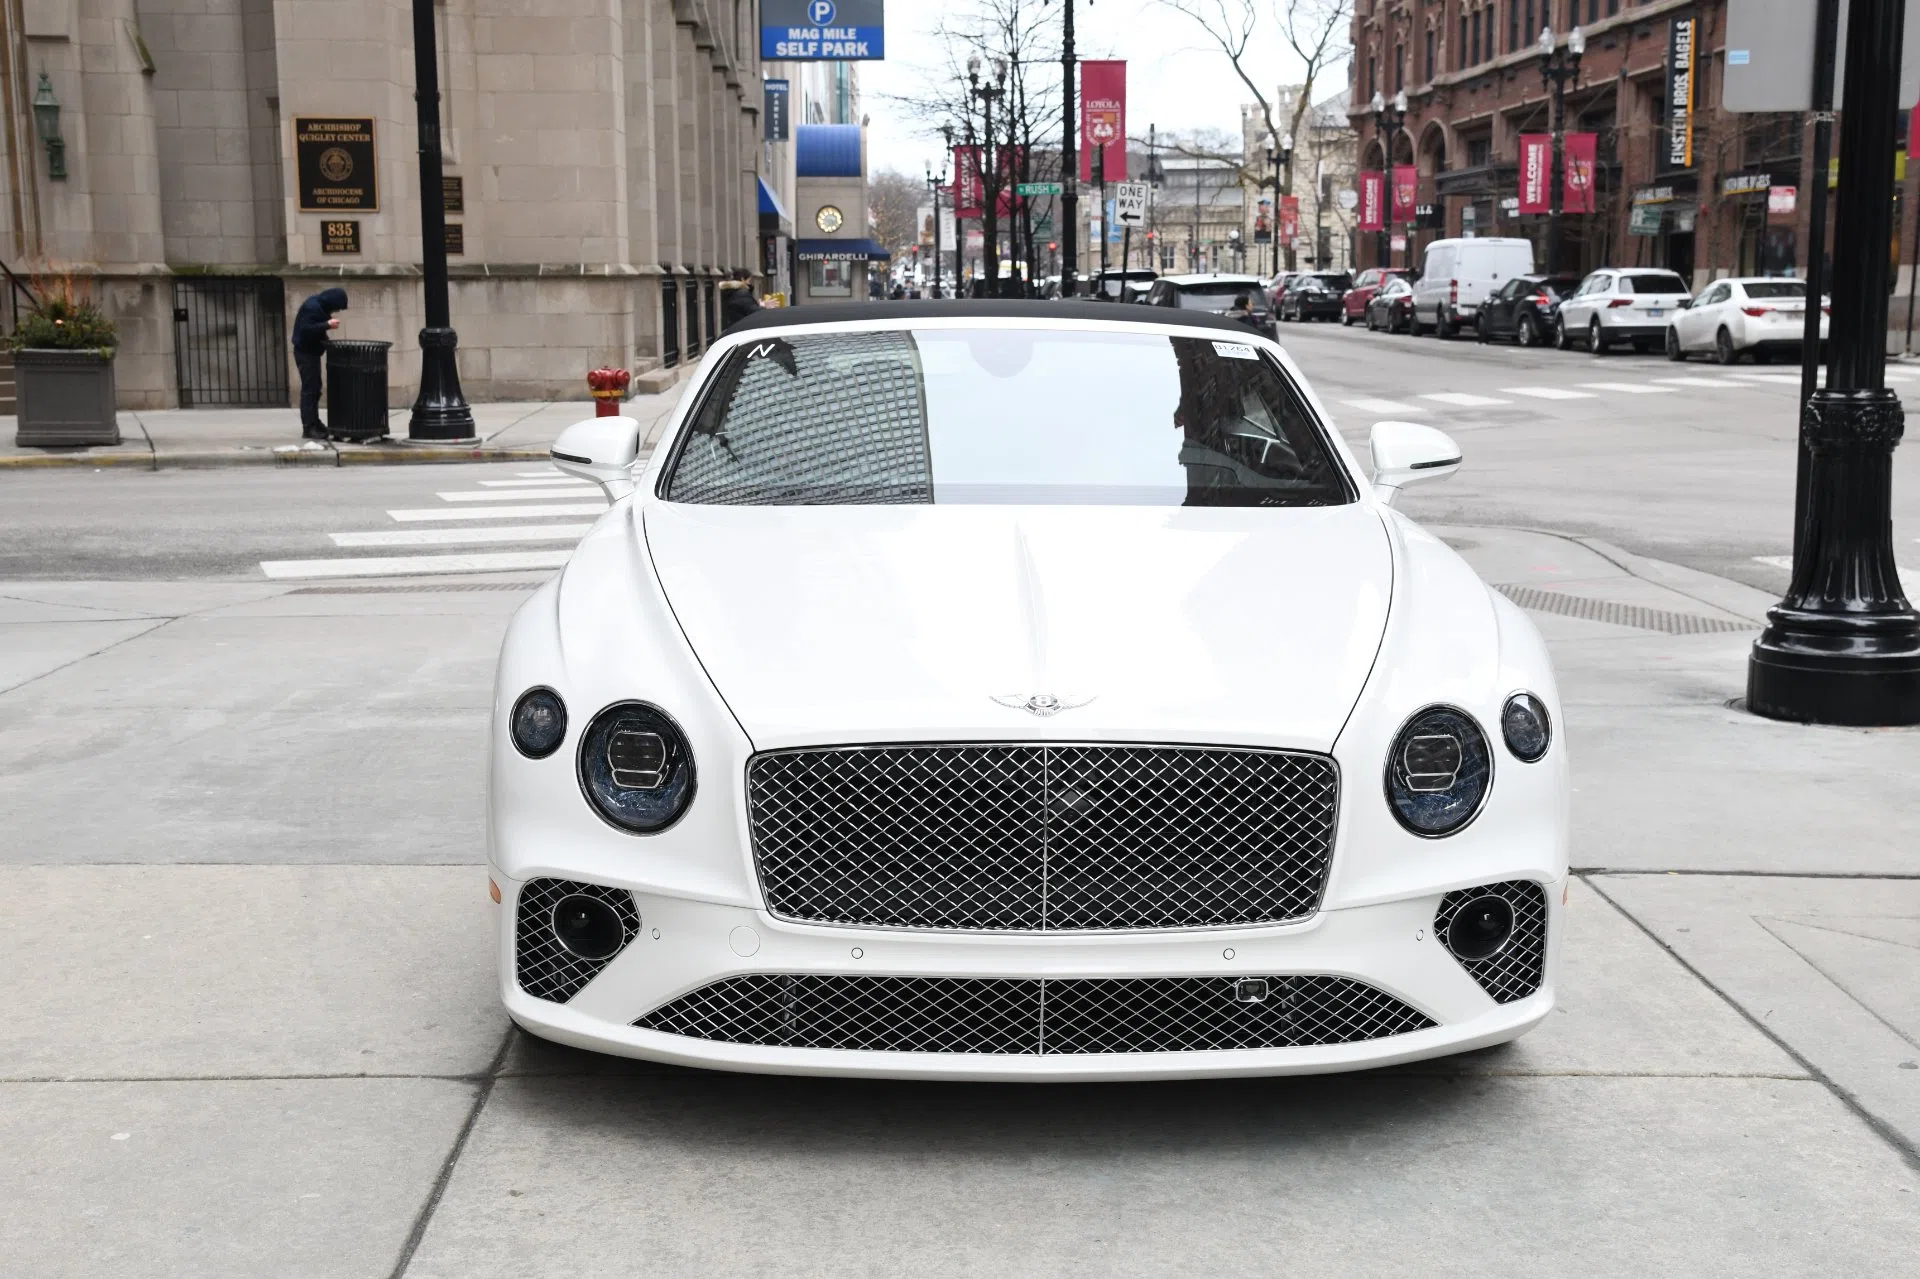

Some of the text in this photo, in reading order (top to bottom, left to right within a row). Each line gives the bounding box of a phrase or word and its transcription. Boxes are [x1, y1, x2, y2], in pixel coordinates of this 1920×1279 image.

[815, 2, 830, 21] P
[788, 28, 856, 40] MAG MILE
[776, 42, 868, 56] SELF PARK
[1675, 21, 1691, 69] BAGELS
[1086, 100, 1120, 109] LOYOLA
[307, 123, 362, 132] ARCHBISHOP
[299, 133, 371, 143] QUIGLEY CENTER
[1671, 108, 1687, 164] EINSTEIN
[1526, 144, 1538, 204] WELCOME
[1025, 184, 1049, 194] RUSH
[1120, 186, 1143, 198] ONE
[317, 196, 360, 204] OF CHICAGO
[1119, 199, 1143, 209] WAY
[1365, 178, 1373, 224] WELCOME
[328, 223, 353, 237] 835
[799, 253, 868, 261] GHIRARDELLI
